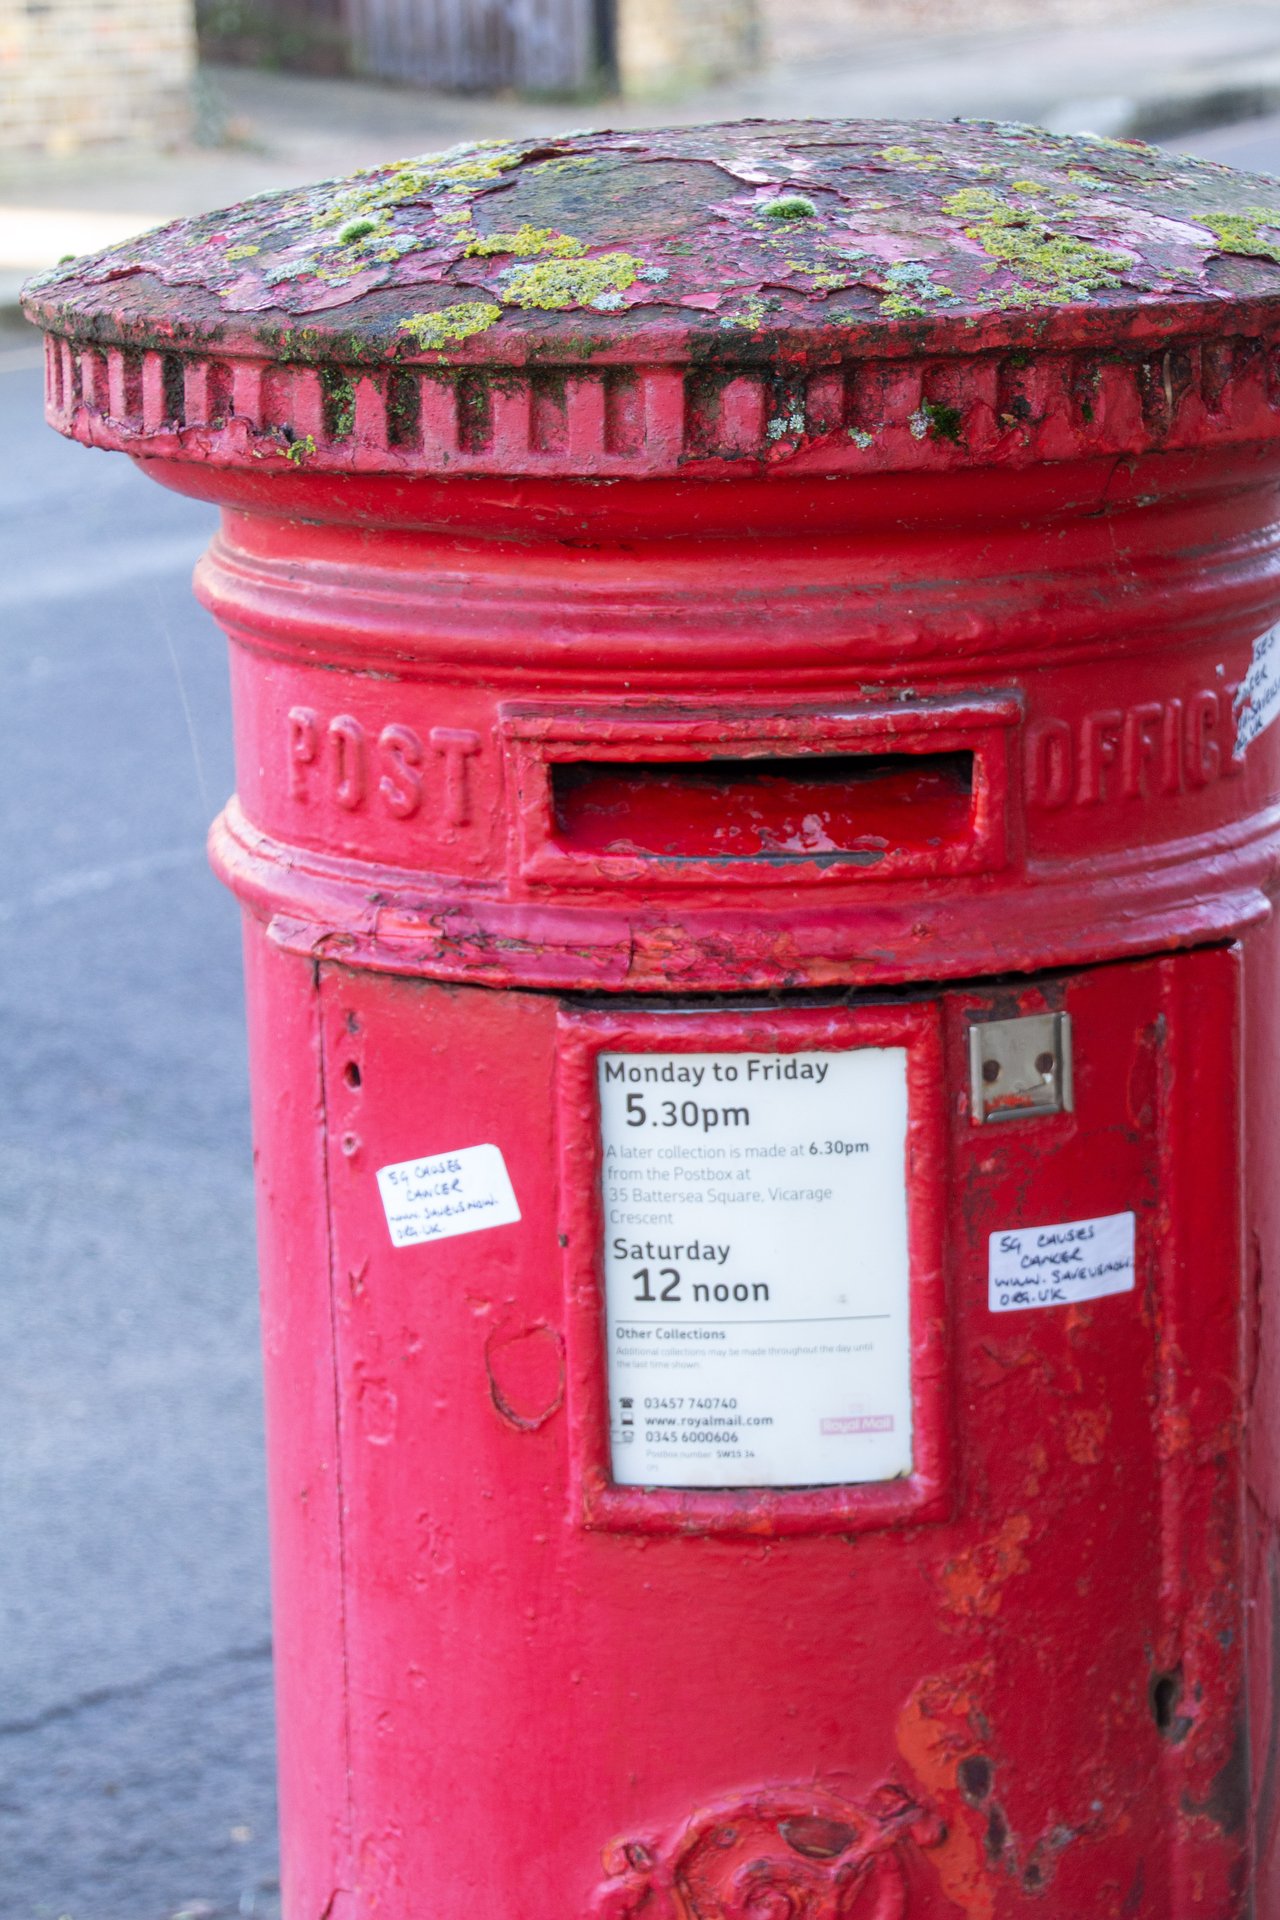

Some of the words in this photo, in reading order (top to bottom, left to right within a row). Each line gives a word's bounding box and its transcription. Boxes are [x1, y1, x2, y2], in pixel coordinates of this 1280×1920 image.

[288, 706, 481, 827] POST
[604, 1060, 705, 1087] Monday
[712, 1062, 738, 1082] to
[747, 1058, 829, 1083] Friday
[626, 1093, 750, 1132] 5.30pm
[606, 1146, 617, 1158] A
[620, 1145, 652, 1159] later
[657, 1144, 725, 1159] collection
[729, 1144, 741, 1159] is
[745, 1143, 786, 1158] made
[790, 1144, 805, 1157] at
[808, 1140, 869, 1156] 6.30pm
[388, 1171, 409, 1187] 5G
[414, 1159, 462, 1179] CAUSES
[607, 1166, 643, 1181] from
[647, 1166, 670, 1181] the
[673, 1166, 733, 1181] Postbox
[736, 1168, 751, 1181] at
[405, 1178, 464, 1202] CANCER
[608, 1187, 628, 1202] 35
[632, 1187, 703, 1203] Battersea
[706, 1188, 765, 1205] Square,
[768, 1186, 832, 1202] Vicarage
[609, 1209, 674, 1225] Crescent
[1000, 1236, 1021, 1254] 5G
[1037, 1225, 1095, 1248] CAUSES
[612, 1238, 731, 1264] Saturday
[1020, 1248, 1083, 1269] CANCER
[632, 1268, 682, 1302] 12
[692, 1281, 770, 1302] noon
[616, 1327, 652, 1339] Other
[655, 1327, 726, 1340] Collections
[616, 1347, 659, 1356] Additional
[660, 1347, 706, 1356] collections
[708, 1349, 726, 1357] may
[741, 1347, 767, 1356] made
[768, 1344, 819, 1357] throughout
[819, 1344, 834, 1353] the
[835, 1343, 851, 1354] day
[853, 1342, 874, 1352] until
[650, 1359, 669, 1368] time
[644, 1397, 684, 1409] 03457
[689, 1397, 737, 1409] 740740
[644, 1414, 773, 1428] www.royalmail.com
[823, 1418, 860, 1434] Royal
[863, 1416, 891, 1430] Mail
[645, 1431, 678, 1443] 0345
[681, 1431, 739, 1443] 6000606
